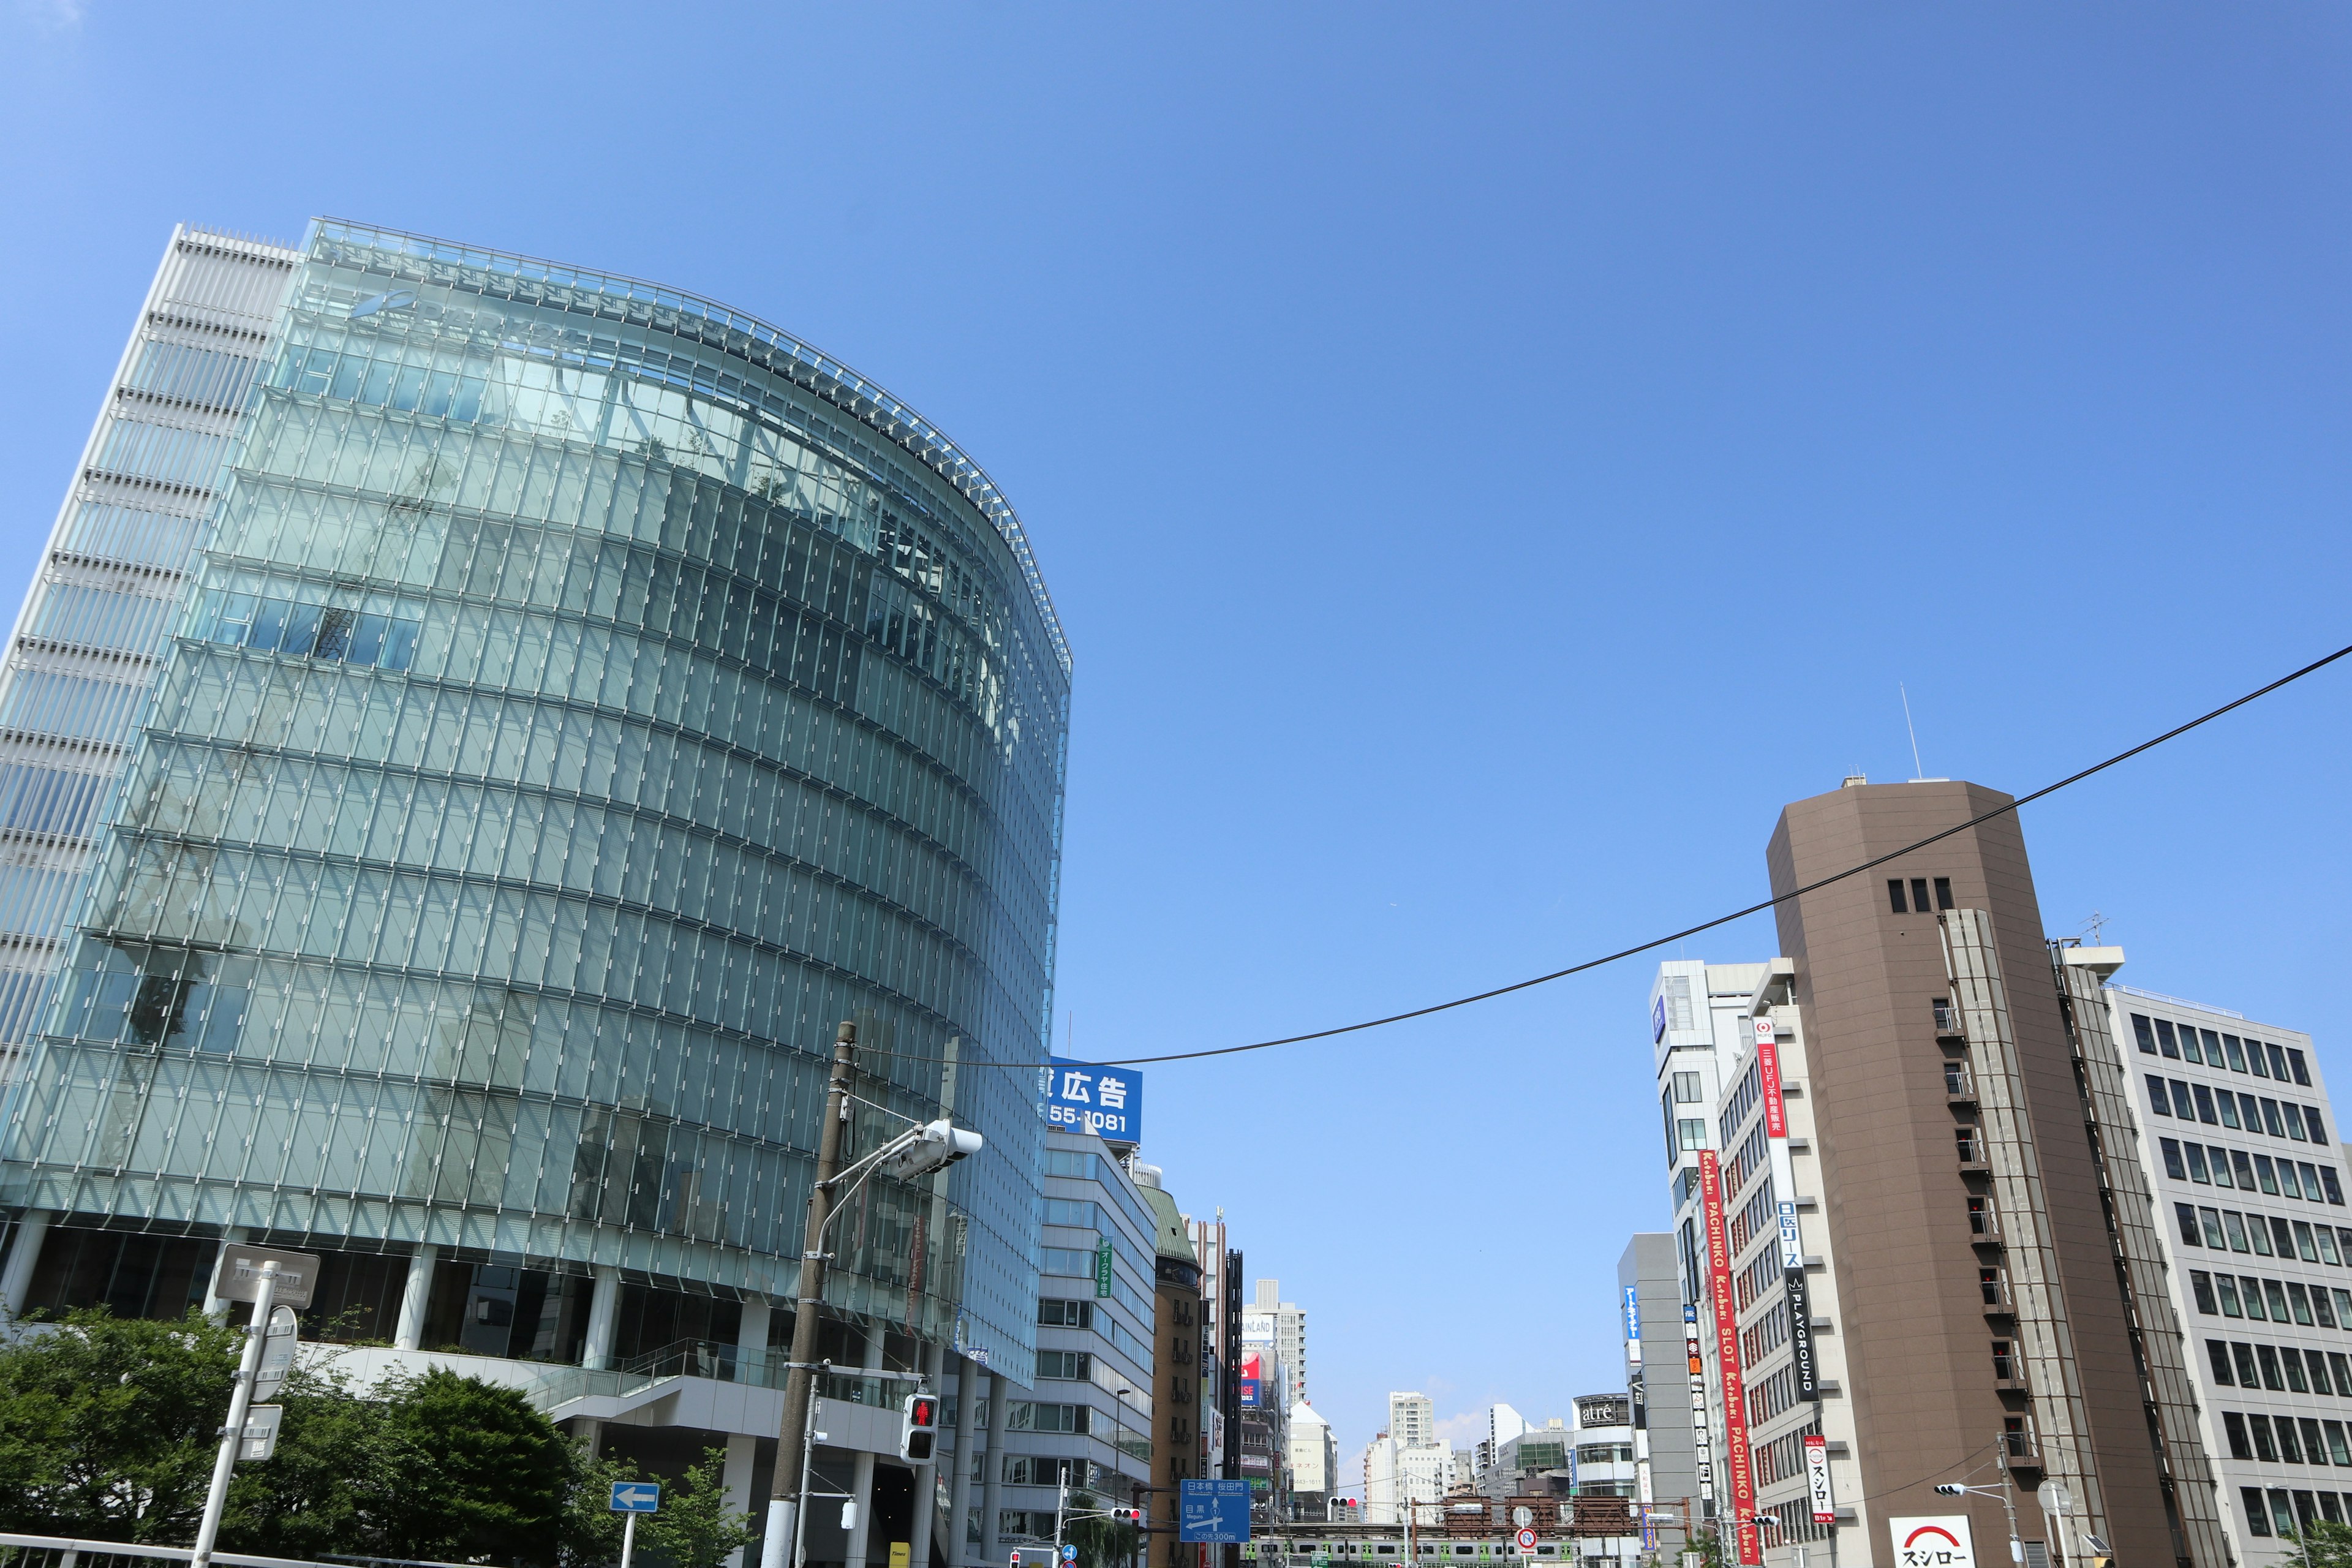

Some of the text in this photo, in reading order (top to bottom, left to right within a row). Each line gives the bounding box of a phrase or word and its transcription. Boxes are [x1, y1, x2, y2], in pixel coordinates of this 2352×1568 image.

[1762, 1049, 1781, 1131] 三菱UFJ不動産販売
[1702, 1152, 1715, 1195] Kotobuki
[1708, 1202, 1724, 1268] PACHINKO
[1777, 1202, 1800, 1266] 日医リース
[1100, 1251, 1109, 1297] オークラヤ住宅
[1716, 1275, 1728, 1320] Kotobuki
[1722, 1328, 1735, 1364] SLOT
[1793, 1294, 1812, 1392] PLAYGROUND
[1583, 1404, 1612, 1421] atré
[1725, 1371, 1739, 1419] Kotobuki
[1732, 1427, 1749, 1499] PACHINKO
[1186, 1505, 1205, 1513] 目黒
[1188, 1482, 1243, 1491] 日本橋 桜田門
[1812, 1466, 1826, 1511] スシロー
[1902, 1550, 1967, 1567] スシロー
